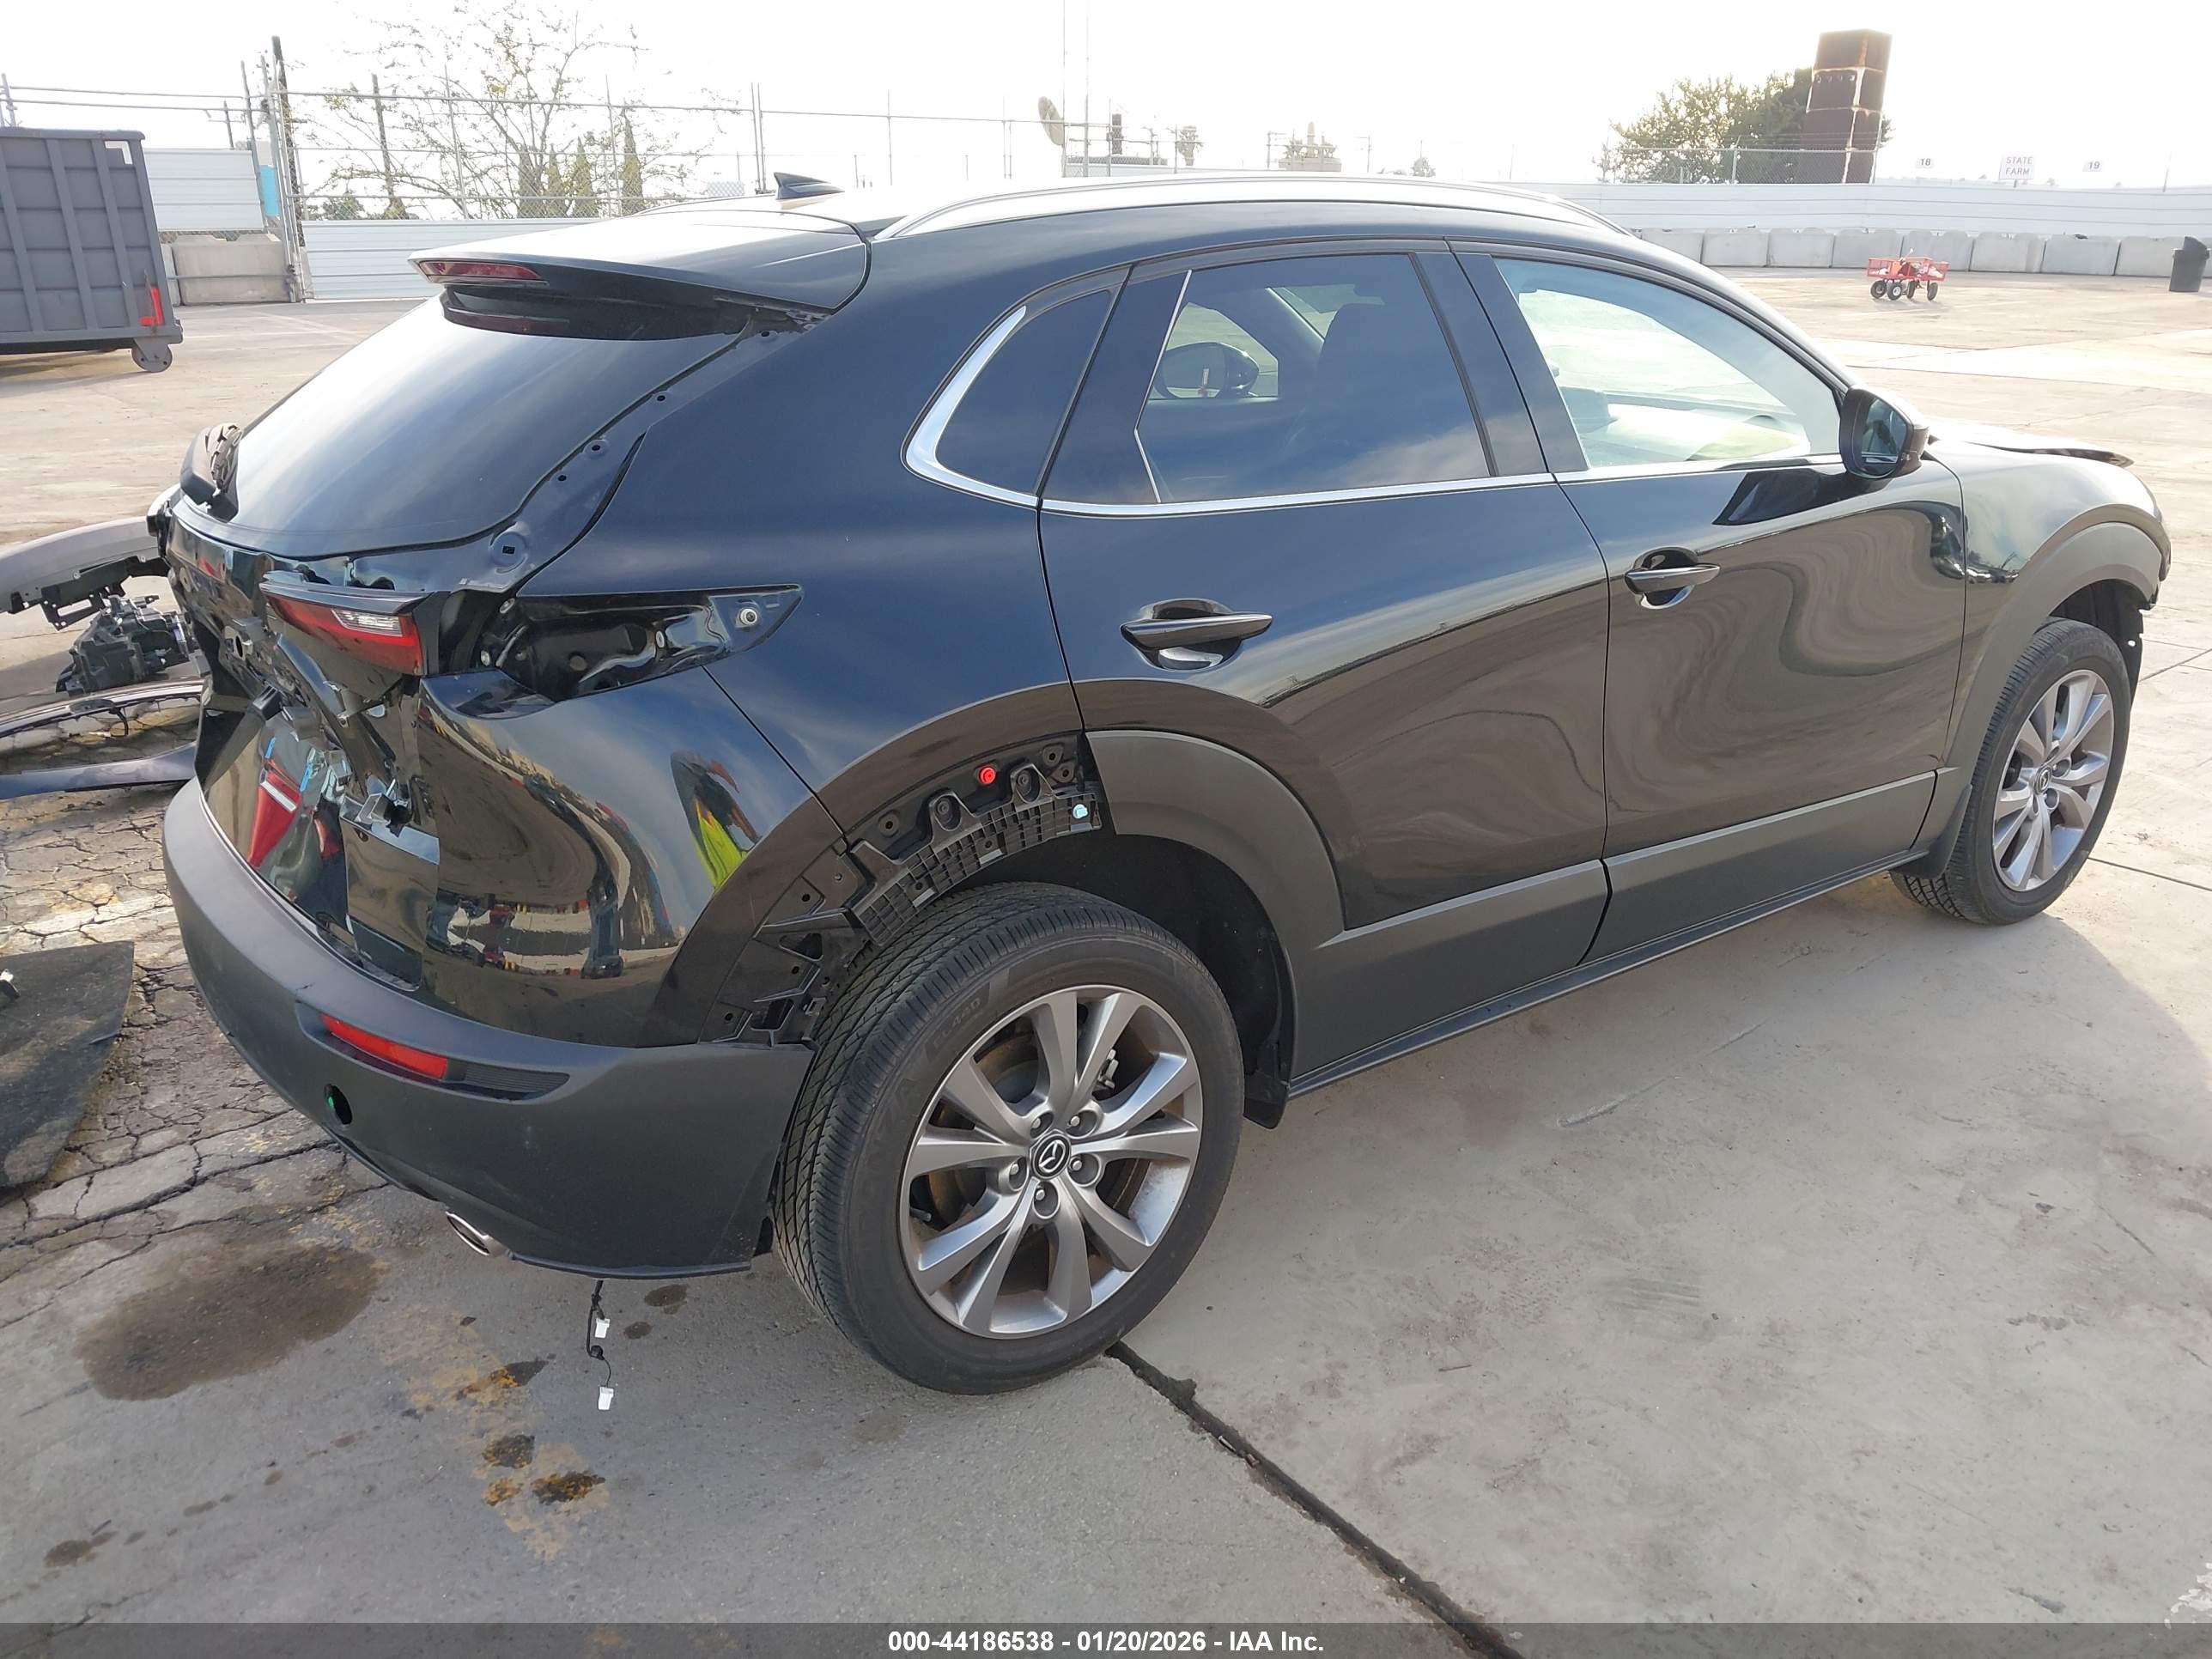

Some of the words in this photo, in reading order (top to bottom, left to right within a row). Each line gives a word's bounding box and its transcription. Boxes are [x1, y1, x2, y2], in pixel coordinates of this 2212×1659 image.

[1920, 158, 1931, 167] 18
[2006, 156, 2033, 165] STATE
[2089, 161, 2100, 170] 19
